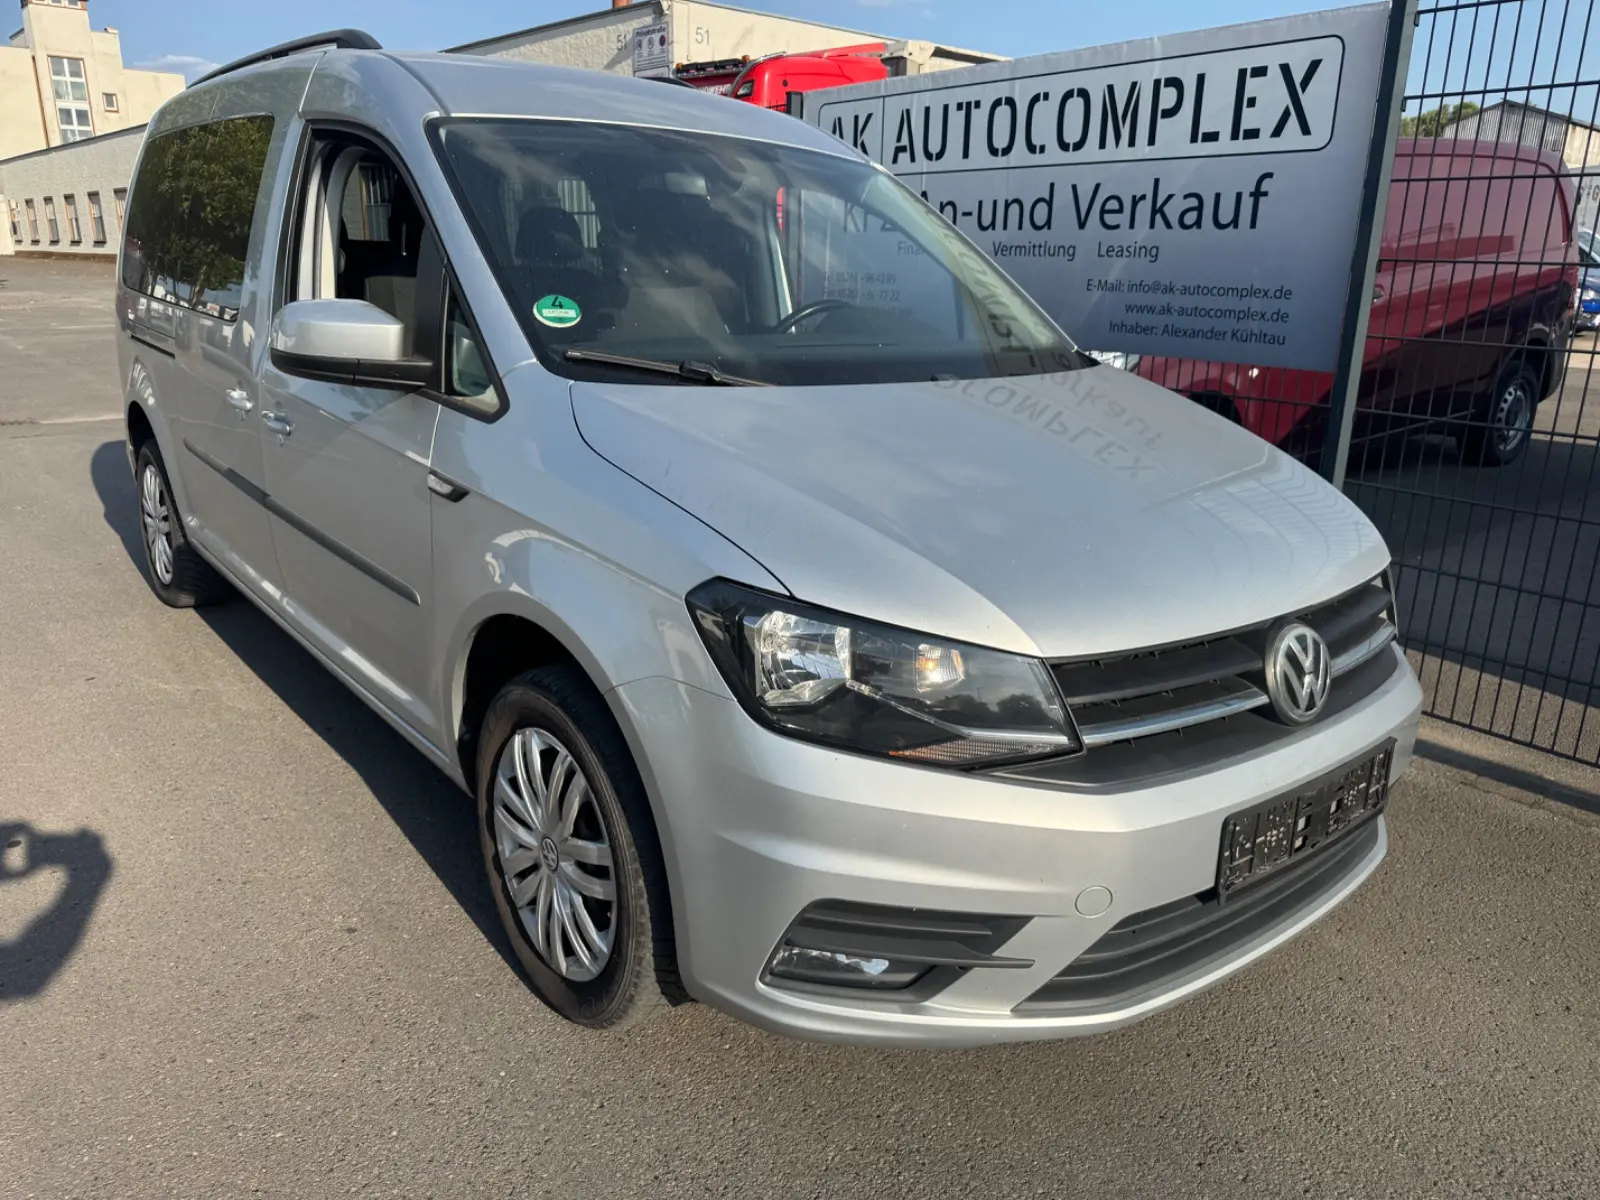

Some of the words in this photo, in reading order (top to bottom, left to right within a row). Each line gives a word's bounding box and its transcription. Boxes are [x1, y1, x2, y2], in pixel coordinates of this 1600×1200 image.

[617, 34, 627, 51] 51
[695, 27, 710, 45] 51
[892, 58, 1323, 165] AUTOCOMPLEX
[1071, 172, 1274, 231] Verkauf
[992, 240, 1077, 262] Vermittlung
[1097, 241, 1160, 262] Leasing
[1086, 278, 1125, 293] E-Mail:
[1127, 279, 1293, 301] info@ak-autocomplex.de
[551, 296, 564, 309] 4
[1124, 302, 1290, 323] www.ak-autocomplex.de
[1108, 320, 1158, 336] Inhaber:
[1160, 323, 1227, 342] Alexander
[1231, 326, 1286, 346] Kühltau
